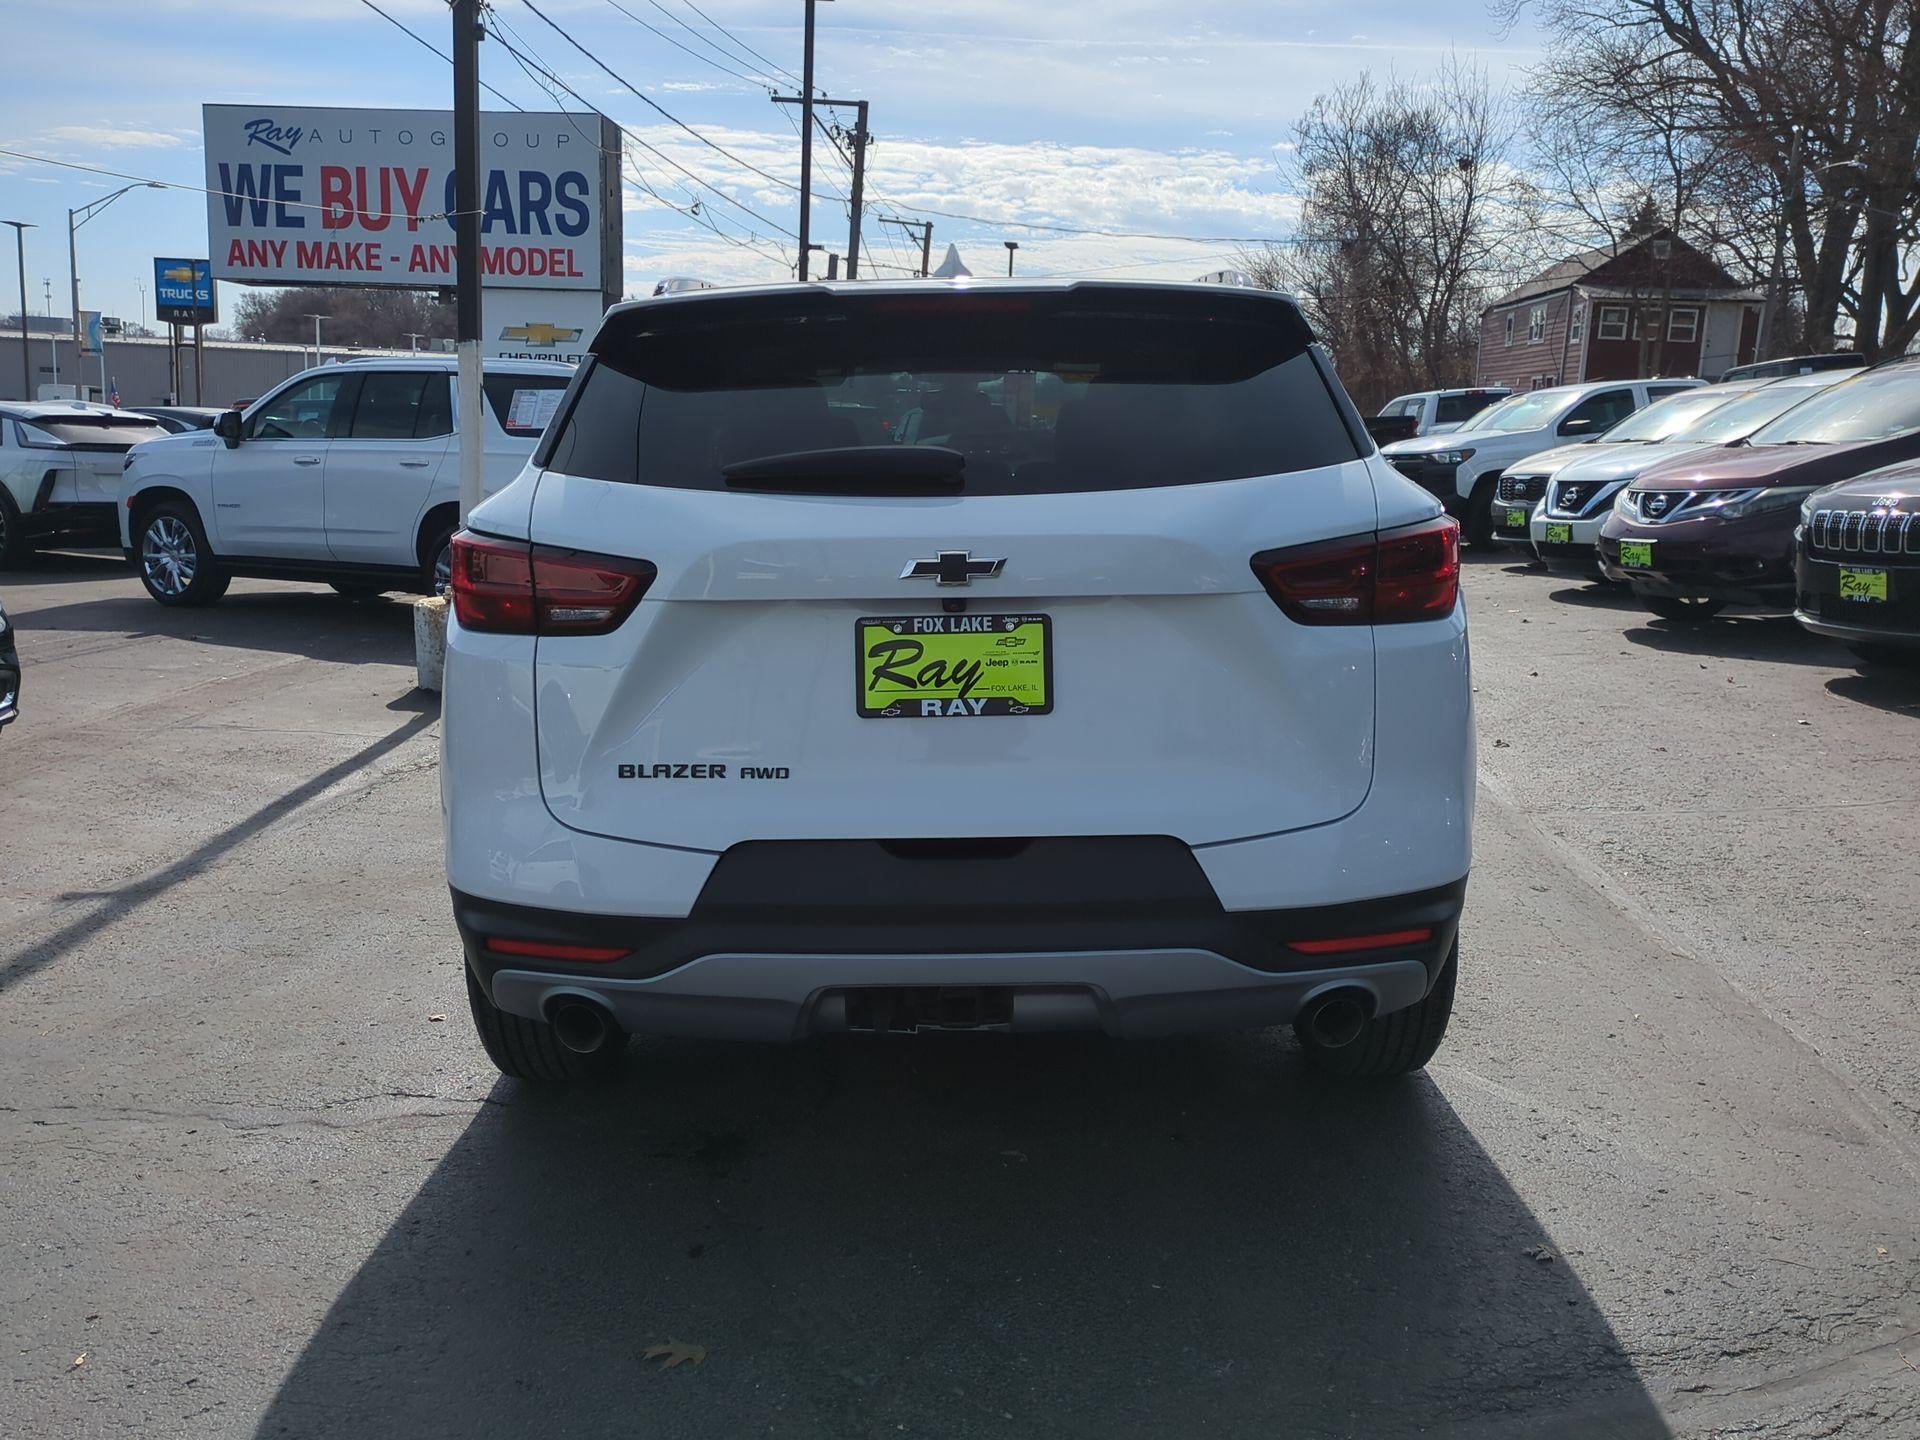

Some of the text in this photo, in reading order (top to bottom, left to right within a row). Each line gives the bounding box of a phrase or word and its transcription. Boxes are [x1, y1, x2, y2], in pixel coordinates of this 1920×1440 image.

[244, 118, 571, 156] Ray AUTOGOUP
[218, 162, 304, 228] WE
[320, 166, 429, 232] BUY
[227, 239, 288, 268] ANY
[297, 241, 382, 271] MAKE
[481, 246, 584, 278] MODEL
[1841, 574, 1871, 597] Ray
[914, 616, 993, 633] FOX LAKE
[1003, 616, 1019, 624] Jeep
[868, 639, 985, 698] Ray
[985, 658, 1009, 668] Jeep
[991, 684, 1006, 692] FOX
[921, 698, 988, 717] RAY
[618, 764, 790, 779] BLAZER AWD
